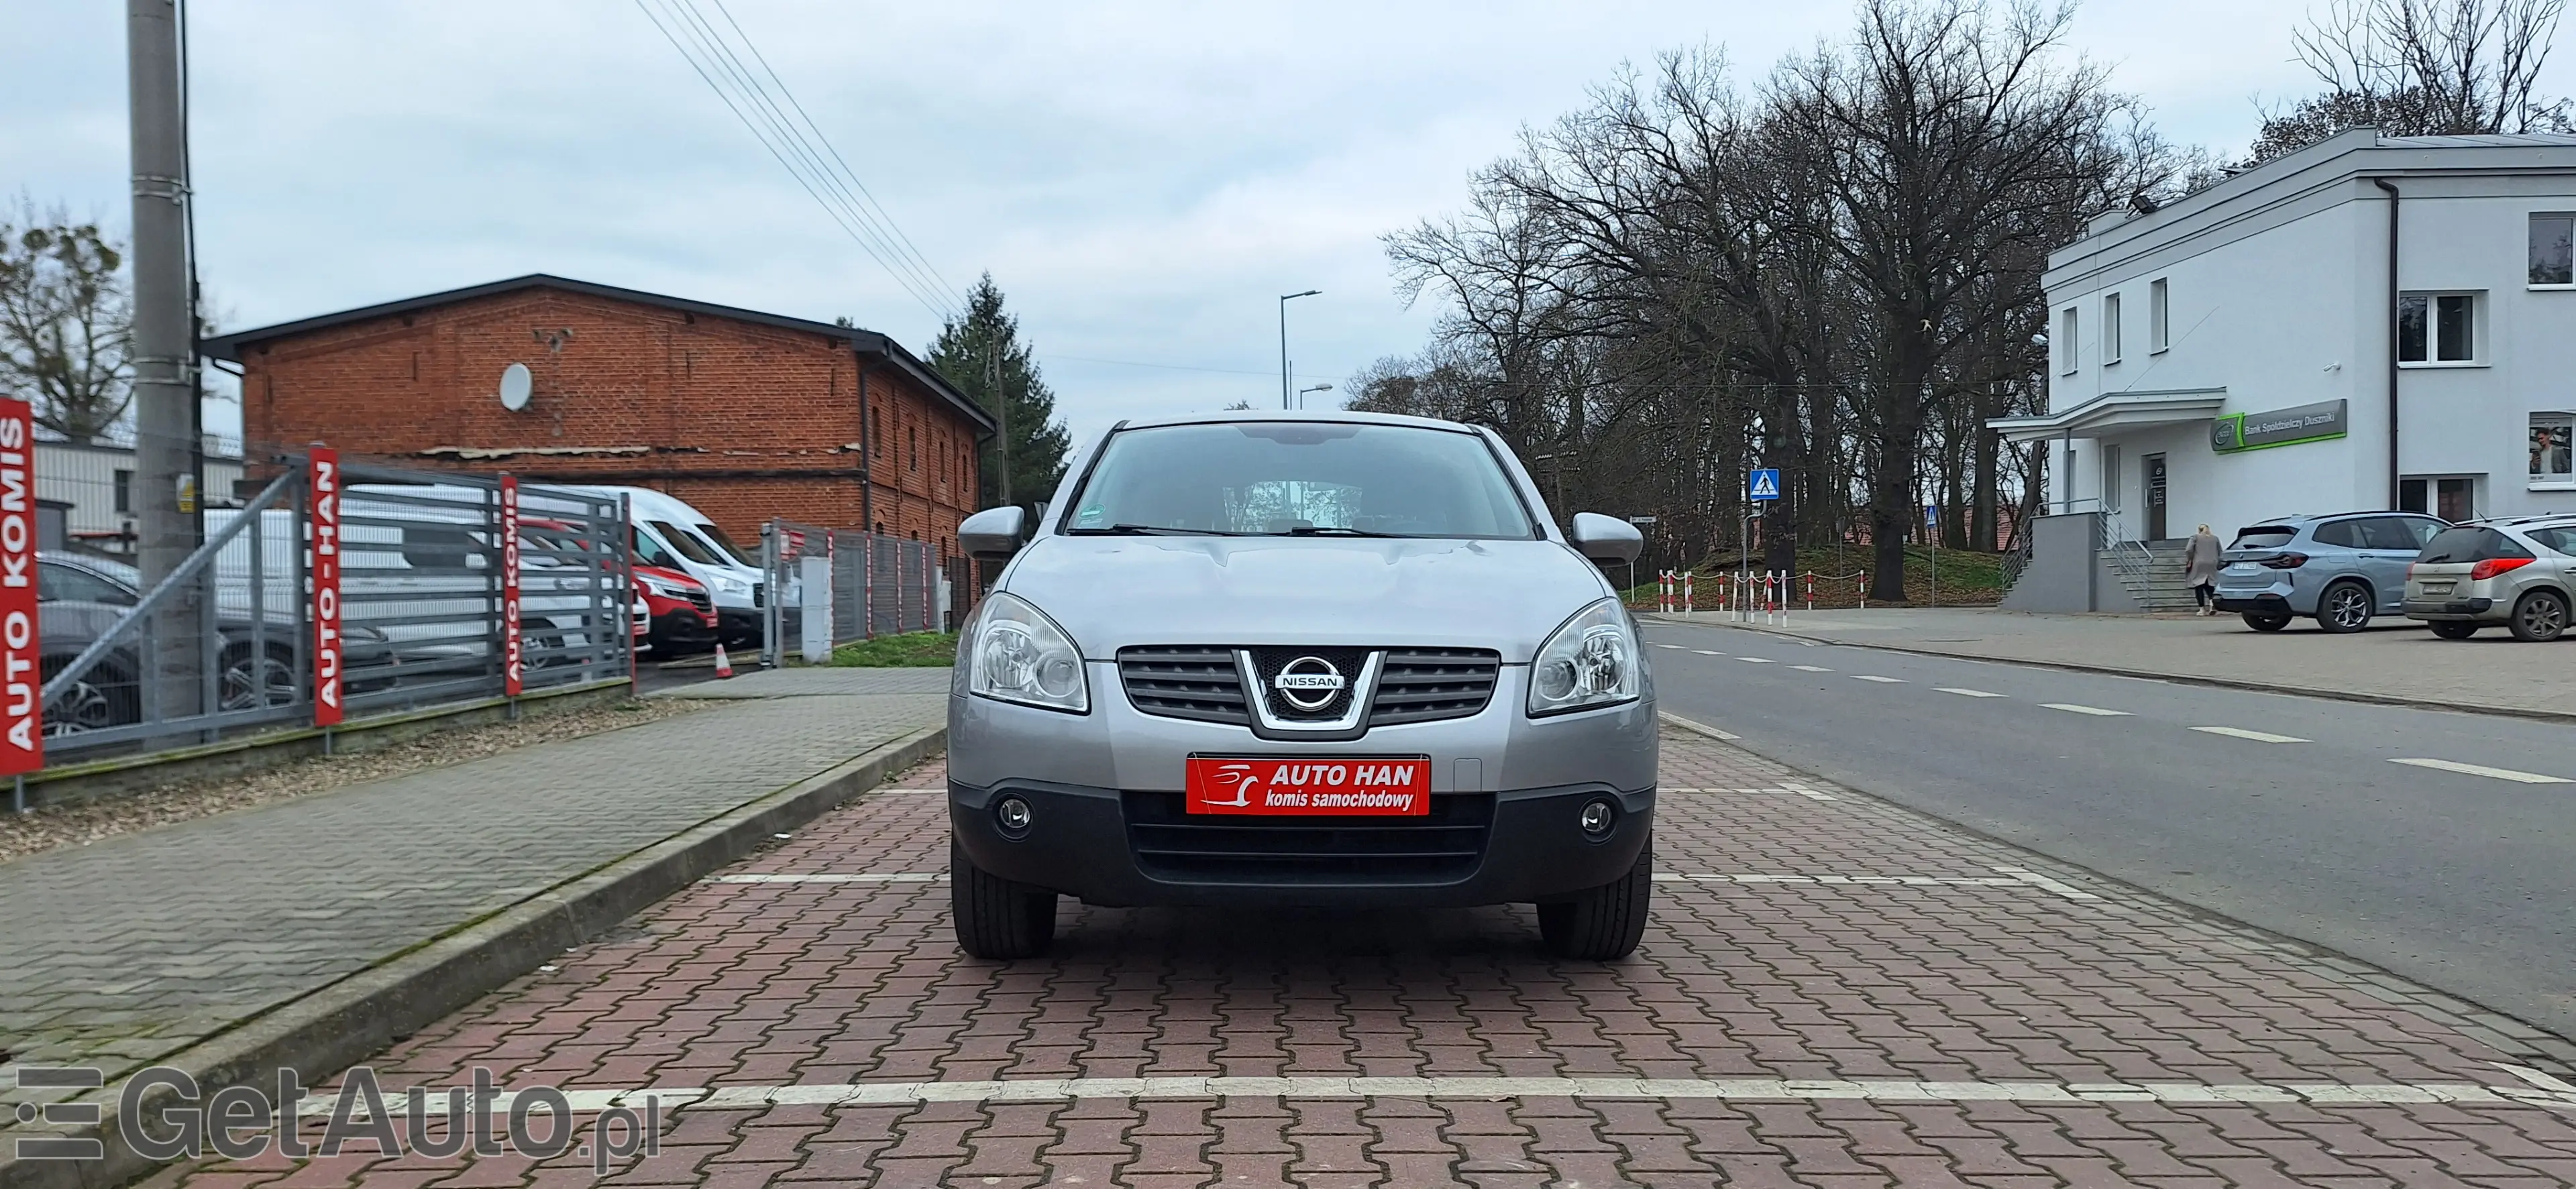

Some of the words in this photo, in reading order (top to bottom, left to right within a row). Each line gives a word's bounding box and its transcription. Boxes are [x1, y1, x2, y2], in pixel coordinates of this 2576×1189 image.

[2245, 424, 2261, 435] Bank
[0, 417, 28, 588] KOMIS
[504, 487, 518, 587] KOMIS
[508, 600, 520, 682] AUTO
[5, 610, 34, 752] AUTO
[1283, 677, 1338, 687] NISSAN
[1265, 789, 1308, 807] komis
[1311, 789, 1414, 811] samochodowy
[1269, 765, 1347, 786] AUTO
[1354, 765, 1414, 786] HAN
